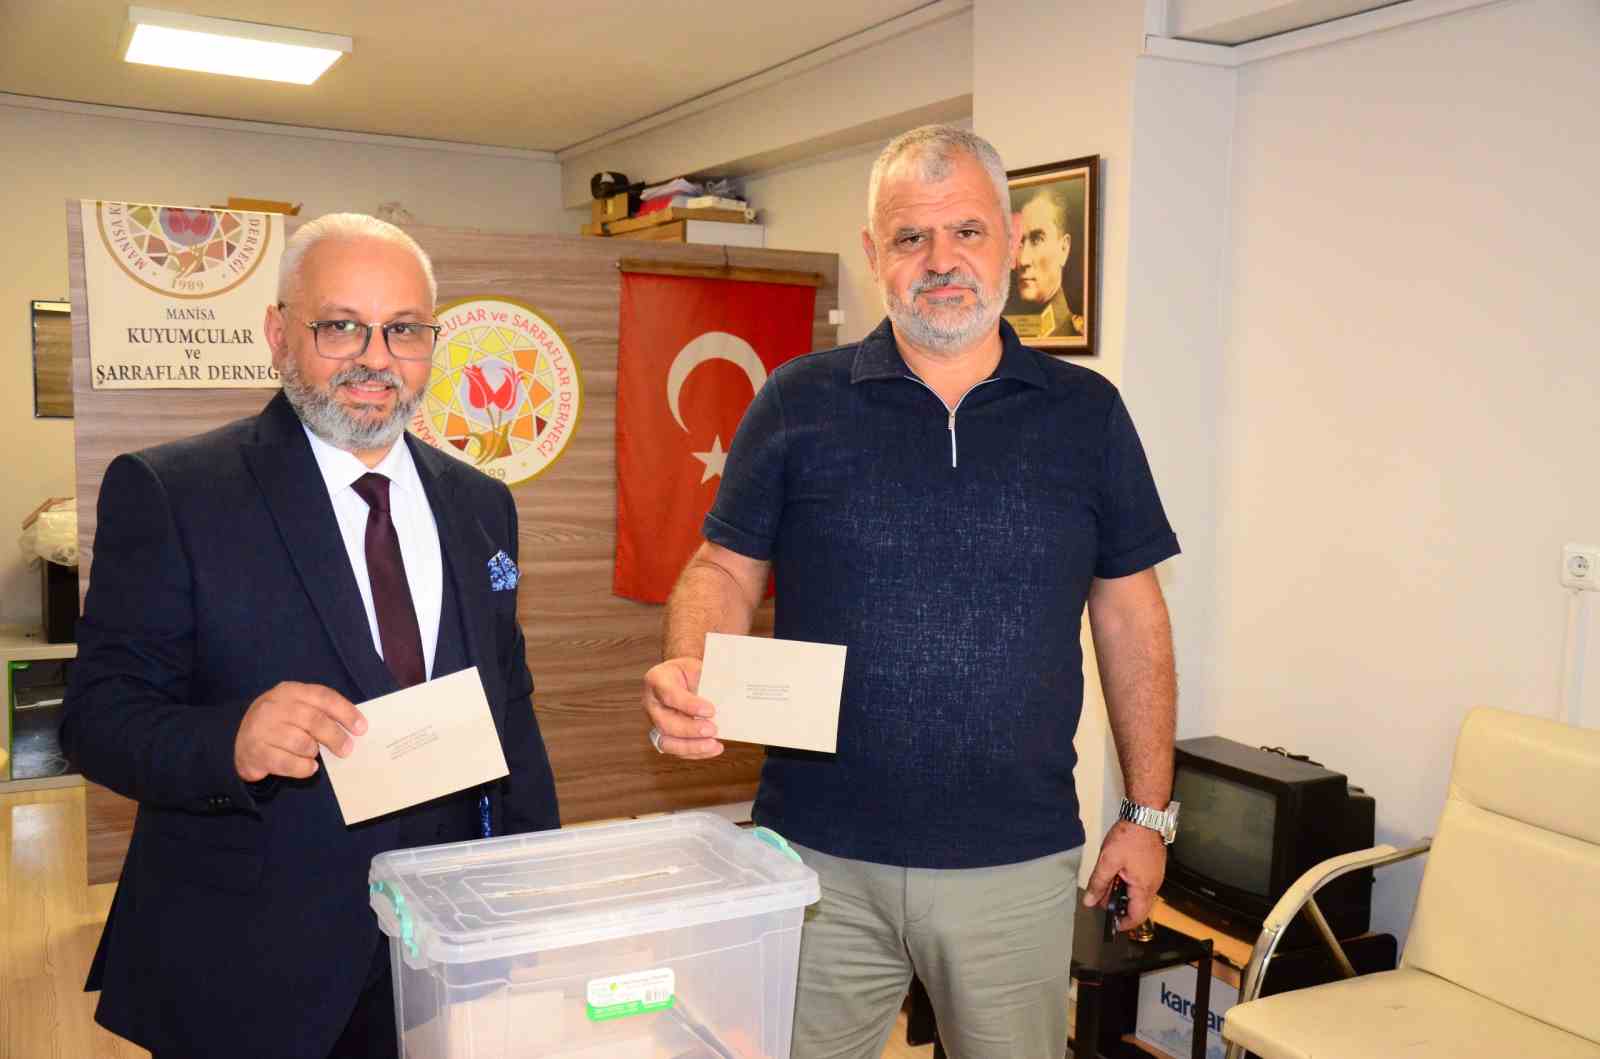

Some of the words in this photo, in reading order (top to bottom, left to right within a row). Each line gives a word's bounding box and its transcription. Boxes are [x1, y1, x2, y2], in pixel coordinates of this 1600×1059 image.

[171, 278, 204, 290] 1989
[166, 307, 216, 321] MANİSA
[127, 327, 254, 344] KUYUMCULAR
[185, 348, 201, 359] ve
[491, 310, 508, 322] ve
[512, 313, 571, 386] SARRAFLAR
